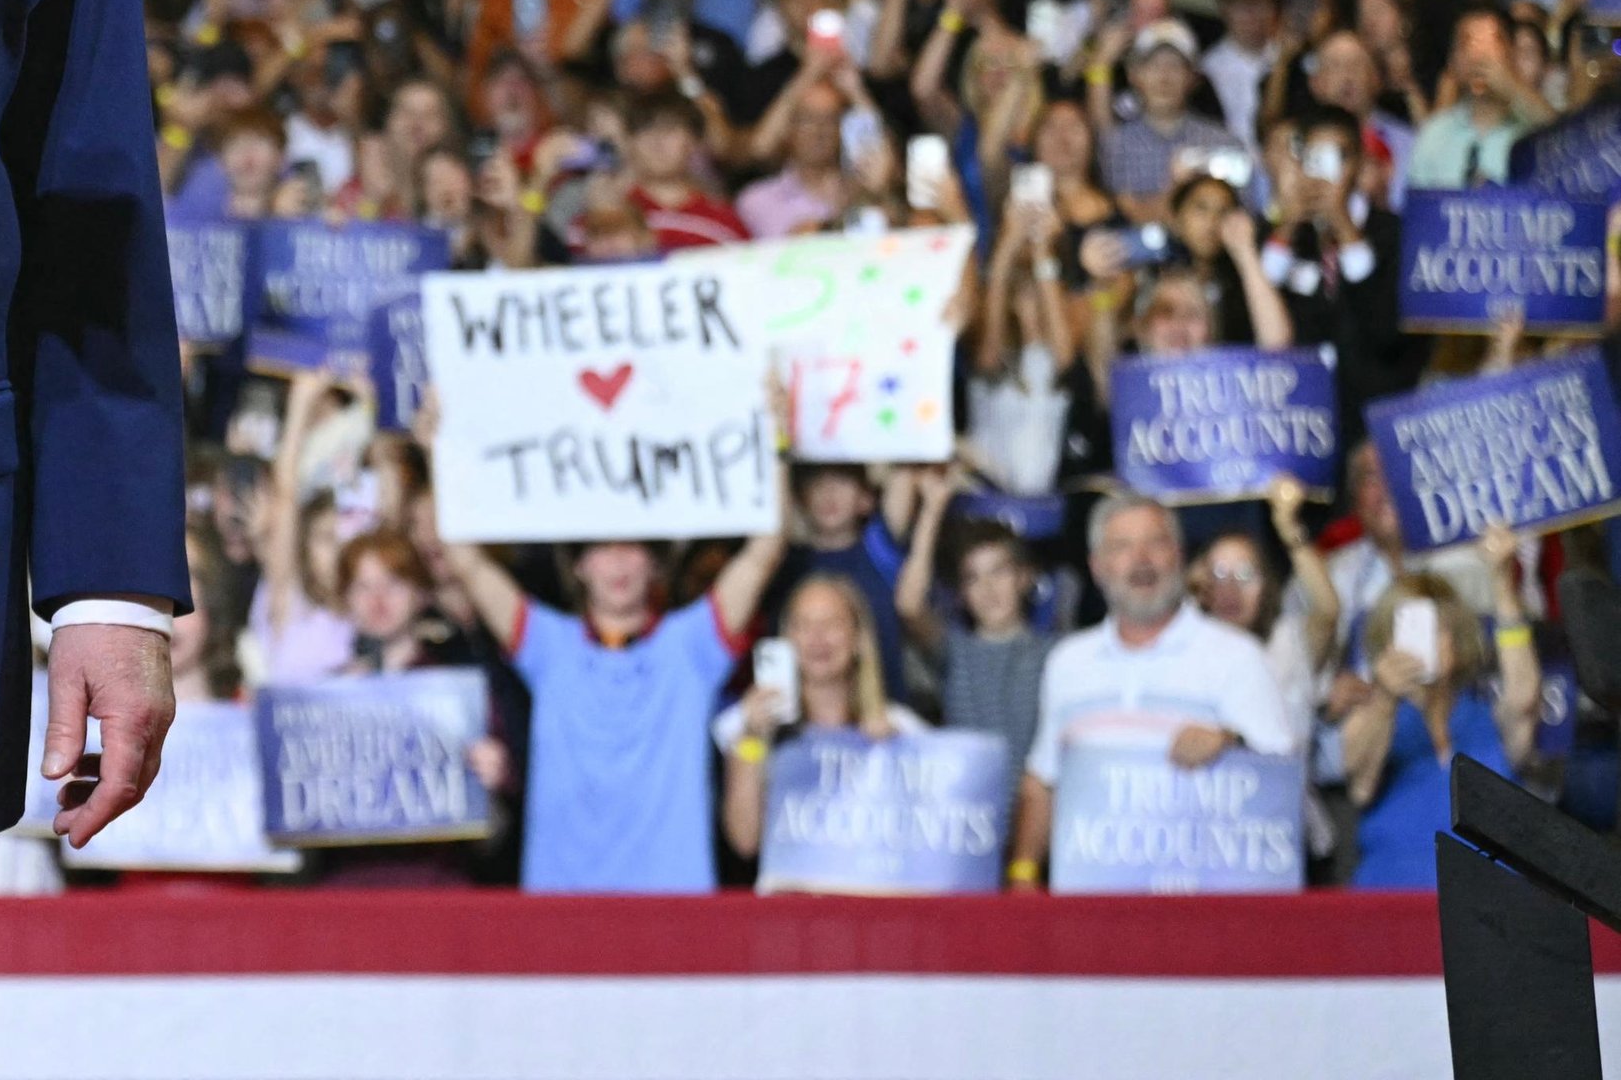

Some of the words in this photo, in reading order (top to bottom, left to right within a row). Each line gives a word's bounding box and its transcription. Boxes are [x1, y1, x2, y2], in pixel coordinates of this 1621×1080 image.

[1440, 199, 1576, 251] TRUMP
[1410, 245, 1602, 298] ACCOUNTS
[448, 278, 742, 356] WHEELER
[1149, 362, 1299, 420] TRUMP
[483, 408, 769, 509] TRUMP!
[1127, 407, 1336, 466] ACCOUNTS
[1417, 440, 1614, 545] DREAM
[280, 762, 468, 829] DREAM
[774, 792, 998, 856] ACCOUNTS
[1066, 816, 1296, 873] ACCOUNTS
